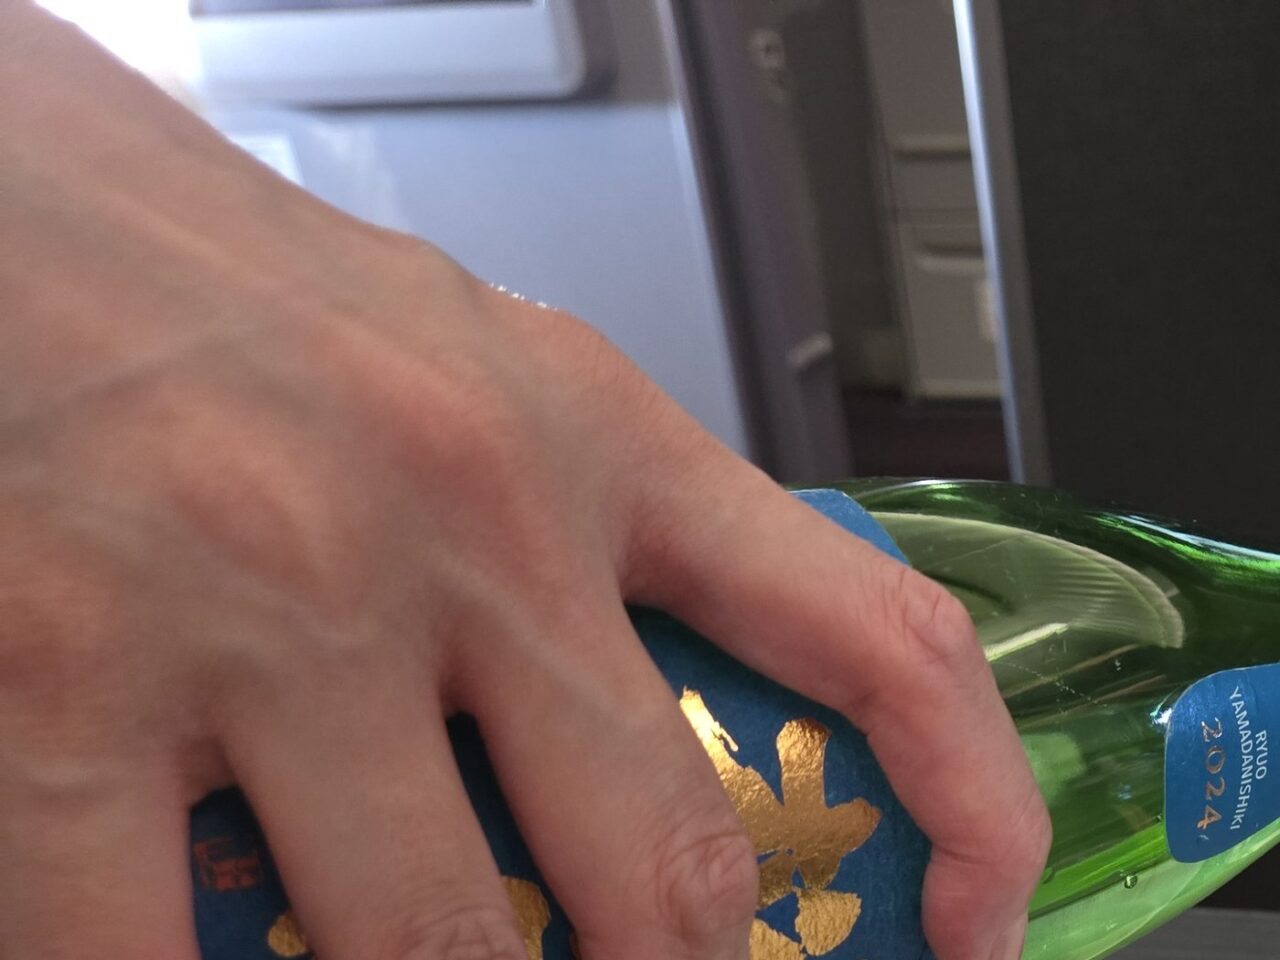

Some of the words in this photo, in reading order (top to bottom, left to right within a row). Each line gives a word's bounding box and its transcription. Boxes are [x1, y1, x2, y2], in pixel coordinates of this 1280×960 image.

[1196, 717, 1226, 830] 2024
[1229, 686, 1254, 831] YAMADANISHIKI
[1255, 730, 1268, 780] RYUO
